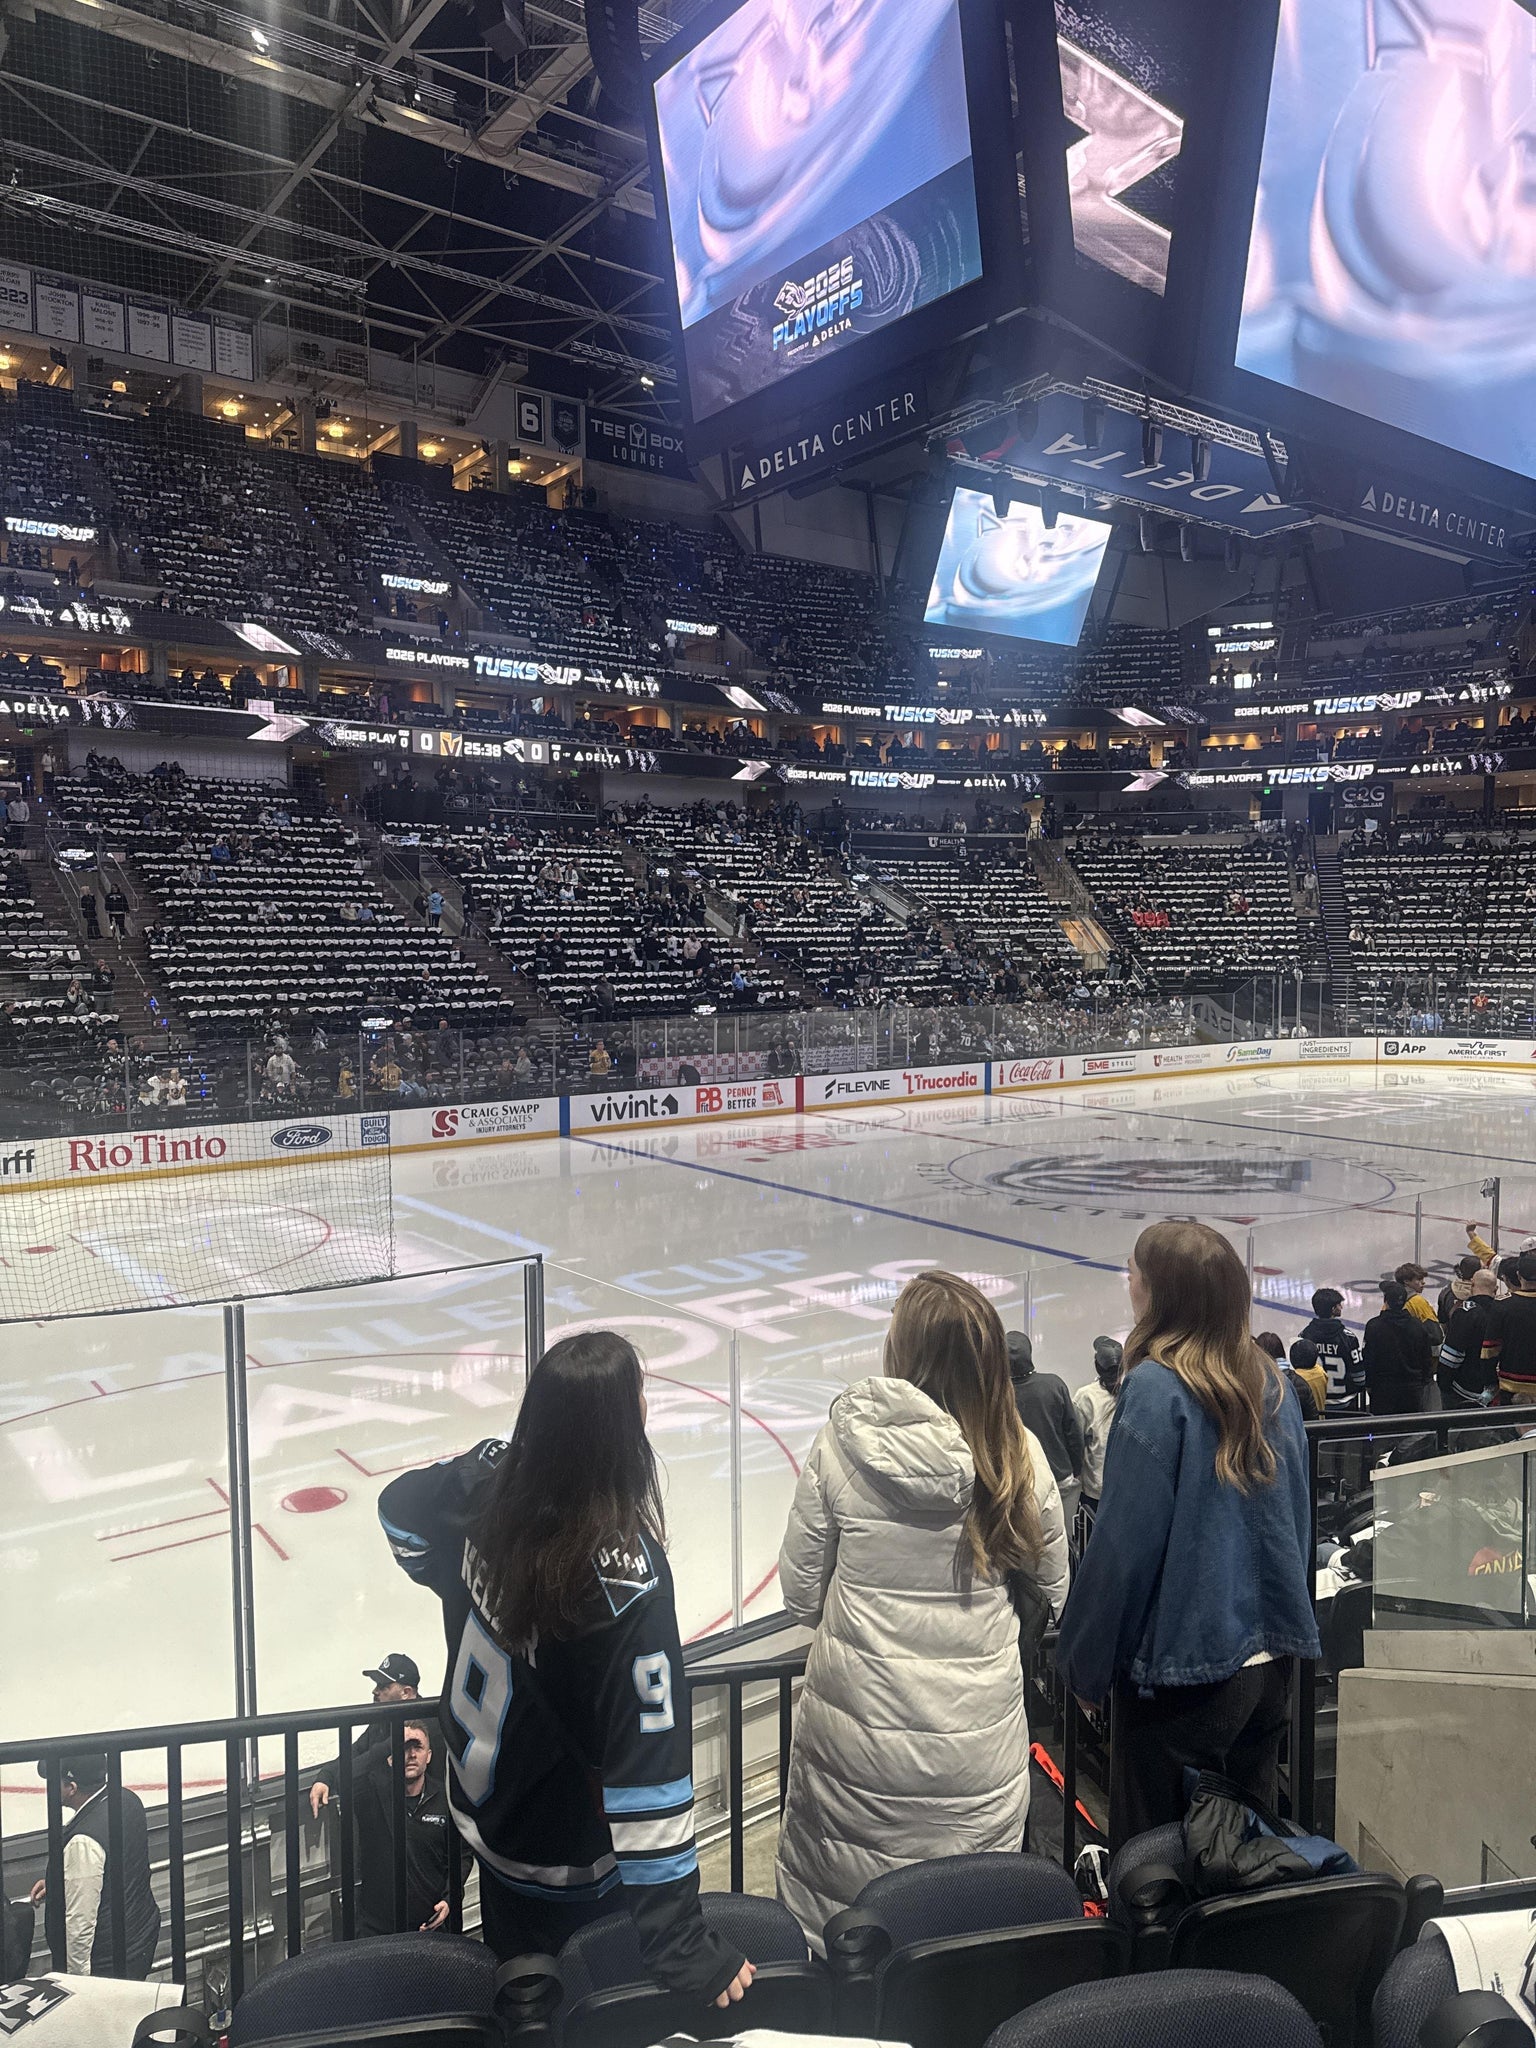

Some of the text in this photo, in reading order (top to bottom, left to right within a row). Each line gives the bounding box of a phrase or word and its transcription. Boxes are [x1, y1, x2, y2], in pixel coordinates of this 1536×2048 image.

[803, 255, 854, 305] 2026
[772, 279, 863, 352] PLAYOFFS
[820, 318, 852, 342] DELTA
[521, 402, 539, 433] 6
[590, 418, 626, 440] TEE
[650, 433, 684, 454] BOX
[759, 392, 917, 479] DELTA CENTER
[613, 445, 664, 470] LOUNGE
[4, 516, 95, 542] TUSKS UP
[1381, 491, 1506, 549] DELTA CENTER
[381, 573, 448, 595] TUSKS UP
[77, 610, 132, 628] DELTA
[665, 618, 718, 636] TUSKS UP
[928, 648, 982, 660] TUSKS UP
[1214, 639, 1276, 654] TUSKS UP
[386, 648, 415, 662] 2026
[416, 651, 470, 669] PLAYOFFS
[473, 655, 539, 681] TUSKS
[555, 666, 582, 686] UP
[625, 677, 660, 692] DELTA
[13, 701, 70, 718] DELTA
[1234, 706, 1260, 717] 2026
[1261, 703, 1309, 716] PLAYOFFS
[1313, 695, 1377, 716] TUSKS
[1396, 690, 1422, 709] UP
[1470, 685, 1512, 699] DELTA
[822, 703, 843, 714] 2026
[843, 704, 881, 717] PLAYOFFS
[884, 704, 936, 724] TUSKS
[949, 708, 973, 725] UP
[1014, 713, 1048, 723] DELTA
[336, 729, 367, 742] 2026
[368, 731, 397, 745] PLAY
[420, 733, 433, 751] 0
[463, 741, 502, 758] 25:38
[531, 743, 543, 760] 0
[585, 751, 621, 764] DELTA
[787, 768, 808, 779] 2026
[808, 771, 847, 782] PLAYOFFS
[849, 769, 900, 788] TUSKS
[911, 773, 936, 789] UP
[974, 778, 1008, 788] DELTA
[1189, 774, 1215, 785] 2026
[1215, 772, 1263, 784] PLAYOFFS
[1266, 766, 1330, 785] TUSKS
[1349, 763, 1375, 781] UP
[1422, 760, 1463, 774] DELTA
[960, 1035, 972, 1048] 70
[1237, 1046, 1273, 1058] SameDay
[1302, 1046, 1349, 1054] INGREDIENTS
[1163, 1054, 1184, 1064] HEALTH
[1447, 1048, 1482, 1058] AMERICA
[1483, 1049, 1508, 1058] FIRST
[1087, 1060, 1134, 1070] SME STEEL
[837, 1079, 891, 1094] FILEVINE
[914, 1071, 978, 1090] Trucordia
[727, 1086, 758, 1099] PEANUT
[590, 1094, 659, 1122] vivint
[727, 1098, 758, 1110] BETTER
[364, 1118, 386, 1128] BUILT
[475, 1123, 527, 1134] INJURY ATTORNEYS
[477, 1113, 533, 1127] ASSOCIATES
[282, 1128, 321, 1146] Ford
[364, 1135, 386, 1144] TOUGH
[611, 1249, 811, 1296] CUP
[598, 1546, 649, 1576] UTAH
[631, 1650, 676, 1735] 9
[450, 1607, 514, 1809] 9
